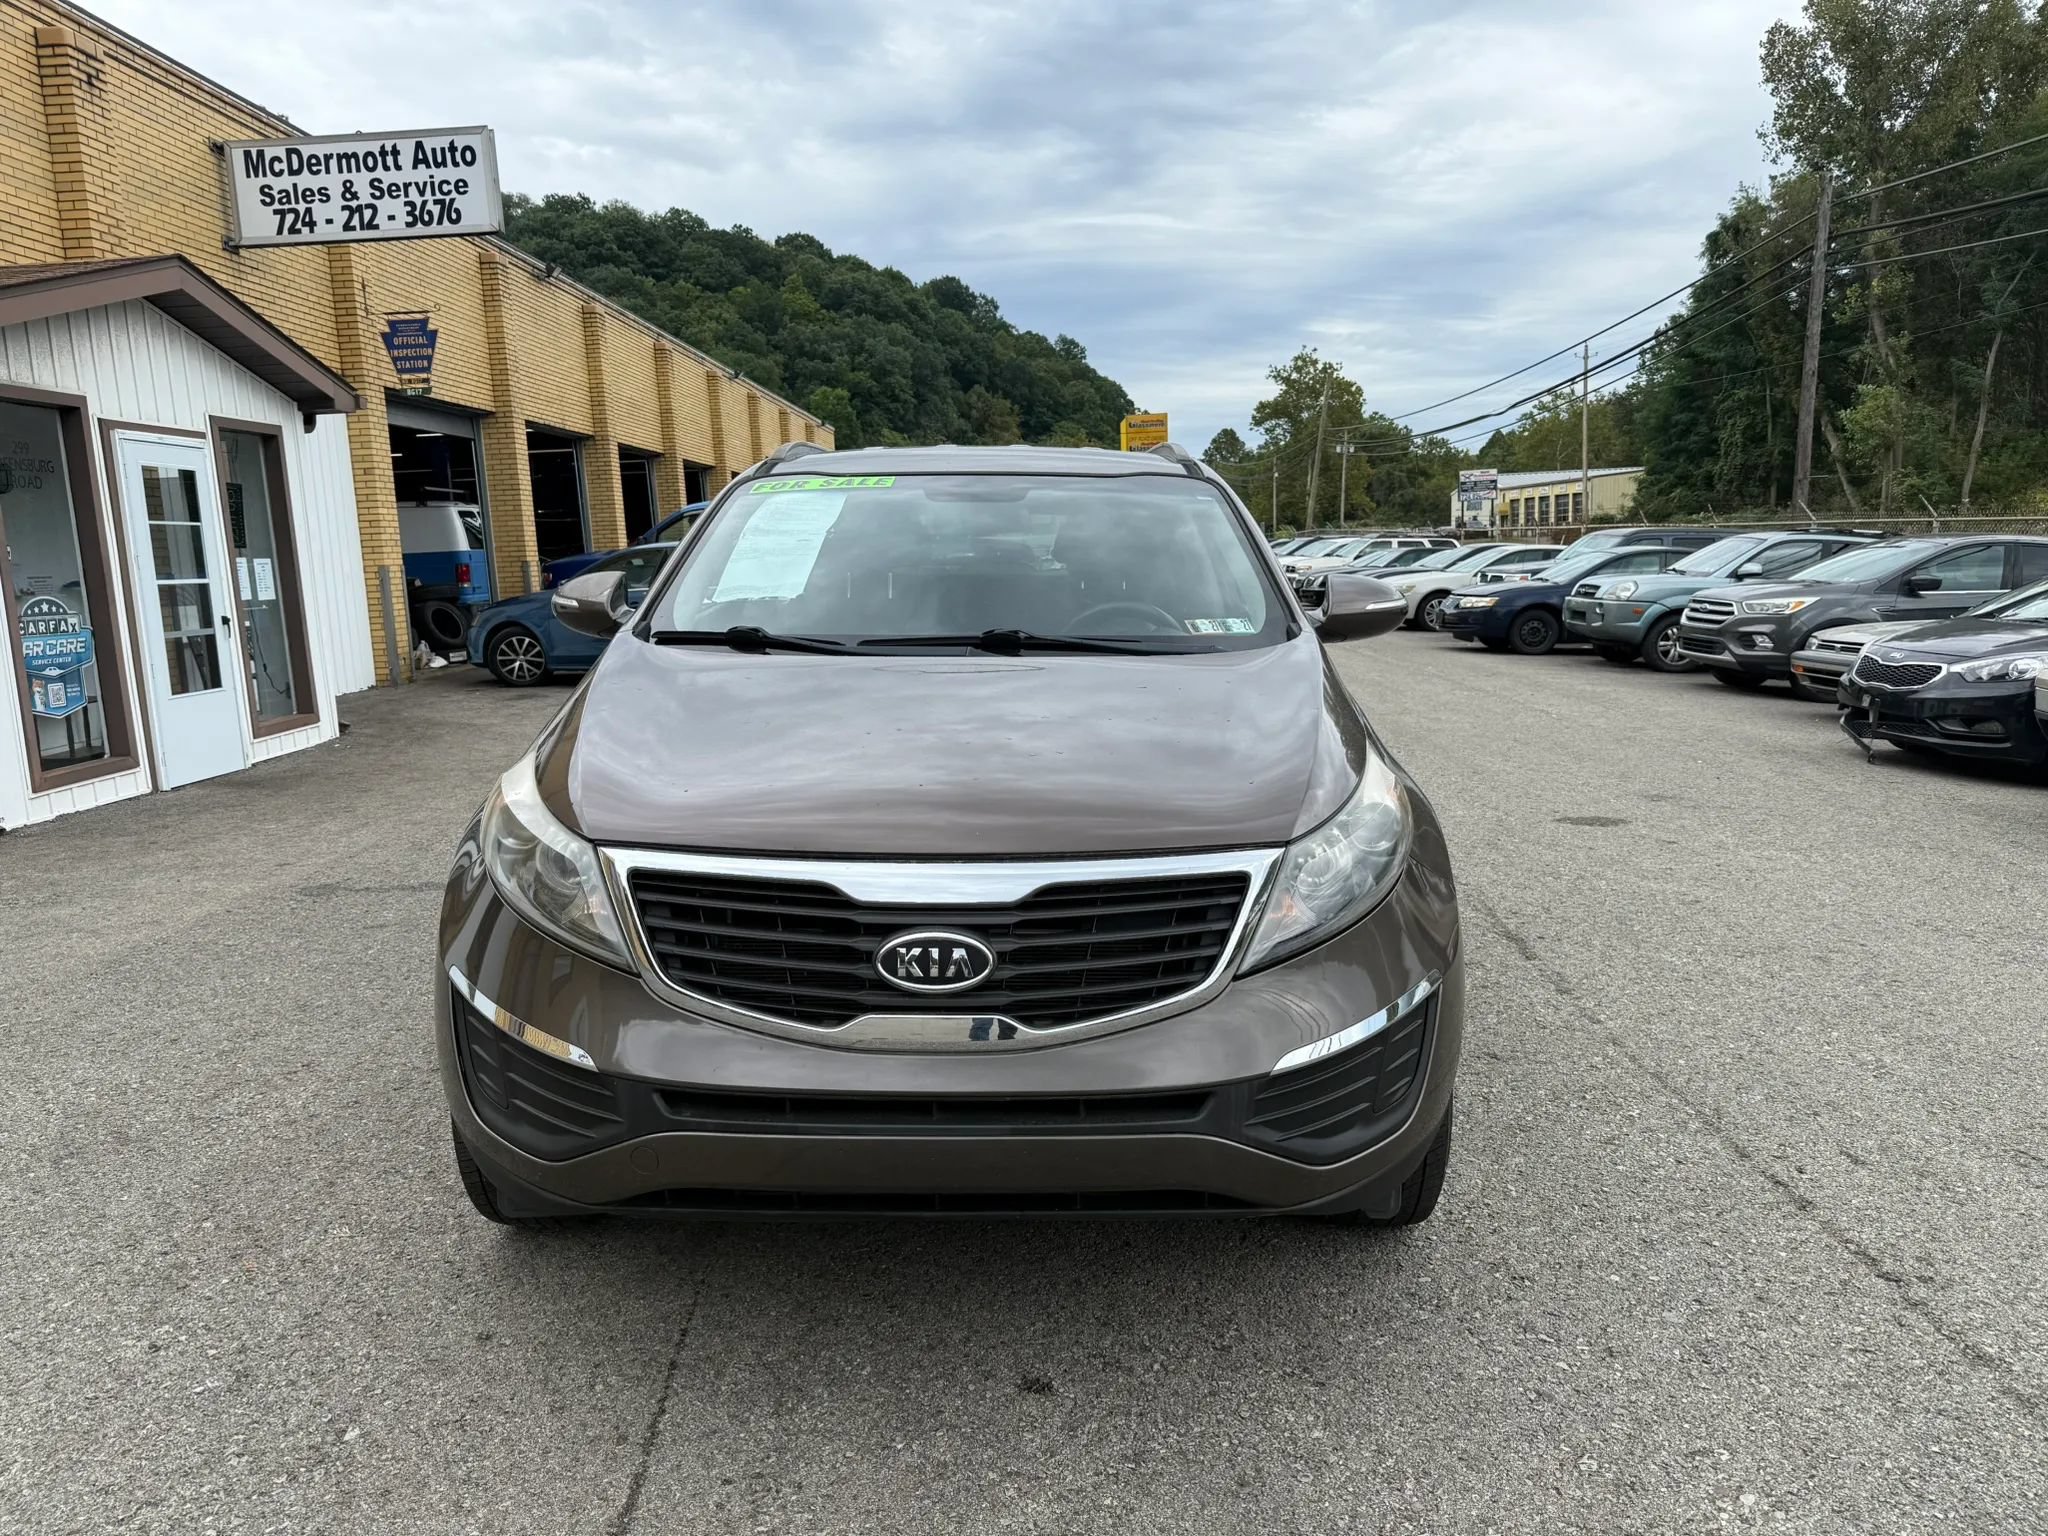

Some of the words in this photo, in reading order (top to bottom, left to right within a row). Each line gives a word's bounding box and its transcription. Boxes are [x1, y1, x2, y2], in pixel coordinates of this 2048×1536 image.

[243, 142, 402, 179] McDermott
[411, 139, 477, 170] Auto
[259, 183, 331, 207] Sales
[341, 179, 360, 201] &
[369, 175, 469, 200] Service
[273, 207, 317, 236] 724
[341, 203, 380, 232] 212
[404, 198, 462, 228] 3676
[393, 336, 428, 345] OFFICIAL
[390, 347, 433, 357] INSPECTION
[396, 360, 429, 369] STATION
[11, 474, 43, 490] ROAD
[753, 481, 808, 492] FOR
[819, 478, 890, 488] SALE
[19, 620, 77, 635] CARFAX
[22, 640, 44, 658] AR
[46, 637, 87, 656] CARE
[32, 658, 52, 666] SERVICE
[53, 656, 72, 664] CENTER
[896, 947, 974, 978] KIA
